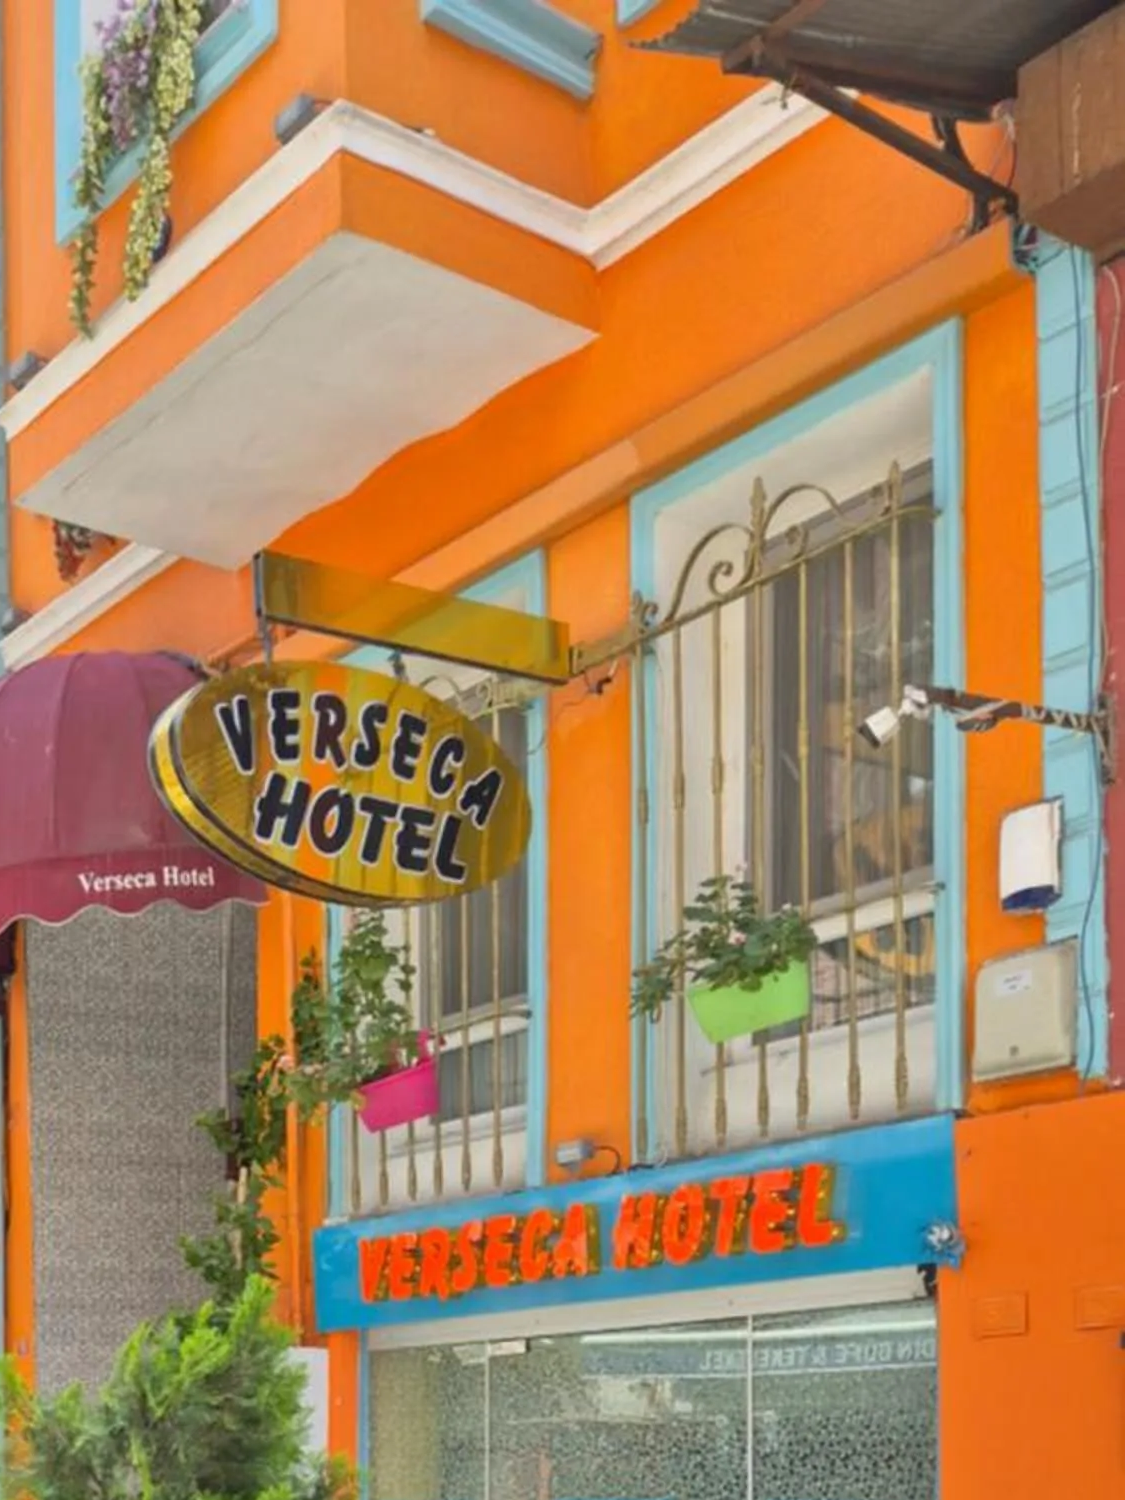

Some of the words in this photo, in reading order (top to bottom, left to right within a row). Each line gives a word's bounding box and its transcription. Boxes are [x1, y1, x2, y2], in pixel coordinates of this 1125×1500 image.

[216, 688, 504, 829] VERSECA
[77, 871, 157, 893] Verseca
[163, 865, 215, 887] Hotel
[254, 770, 467, 883] HOTEL
[357, 1202, 600, 1302] VERSECA
[611, 1163, 847, 1270] HOTEL
